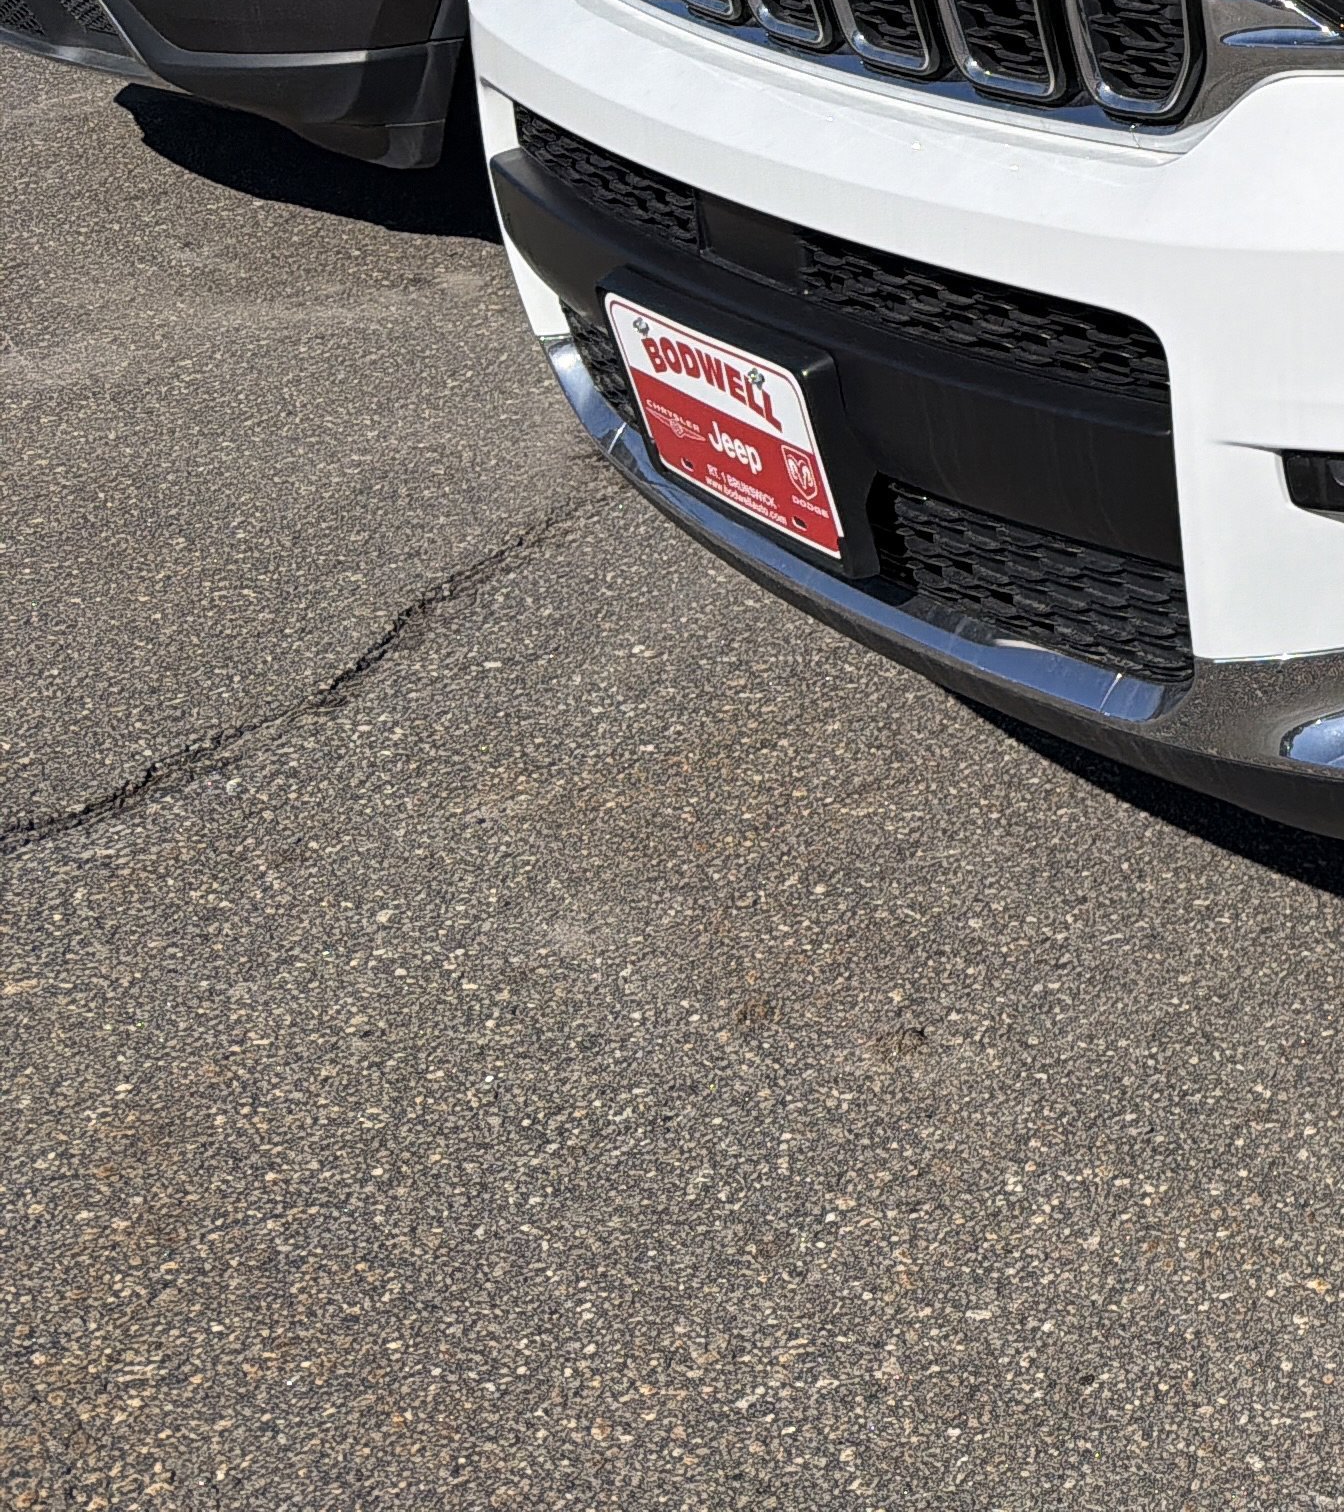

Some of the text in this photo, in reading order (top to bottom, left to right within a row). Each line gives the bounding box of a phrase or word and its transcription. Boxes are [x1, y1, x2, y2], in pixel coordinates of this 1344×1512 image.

[641, 336, 783, 434] BODWELL
[646, 399, 763, 474] CHRYSLER Jeep
[791, 494, 830, 519] DODGE
